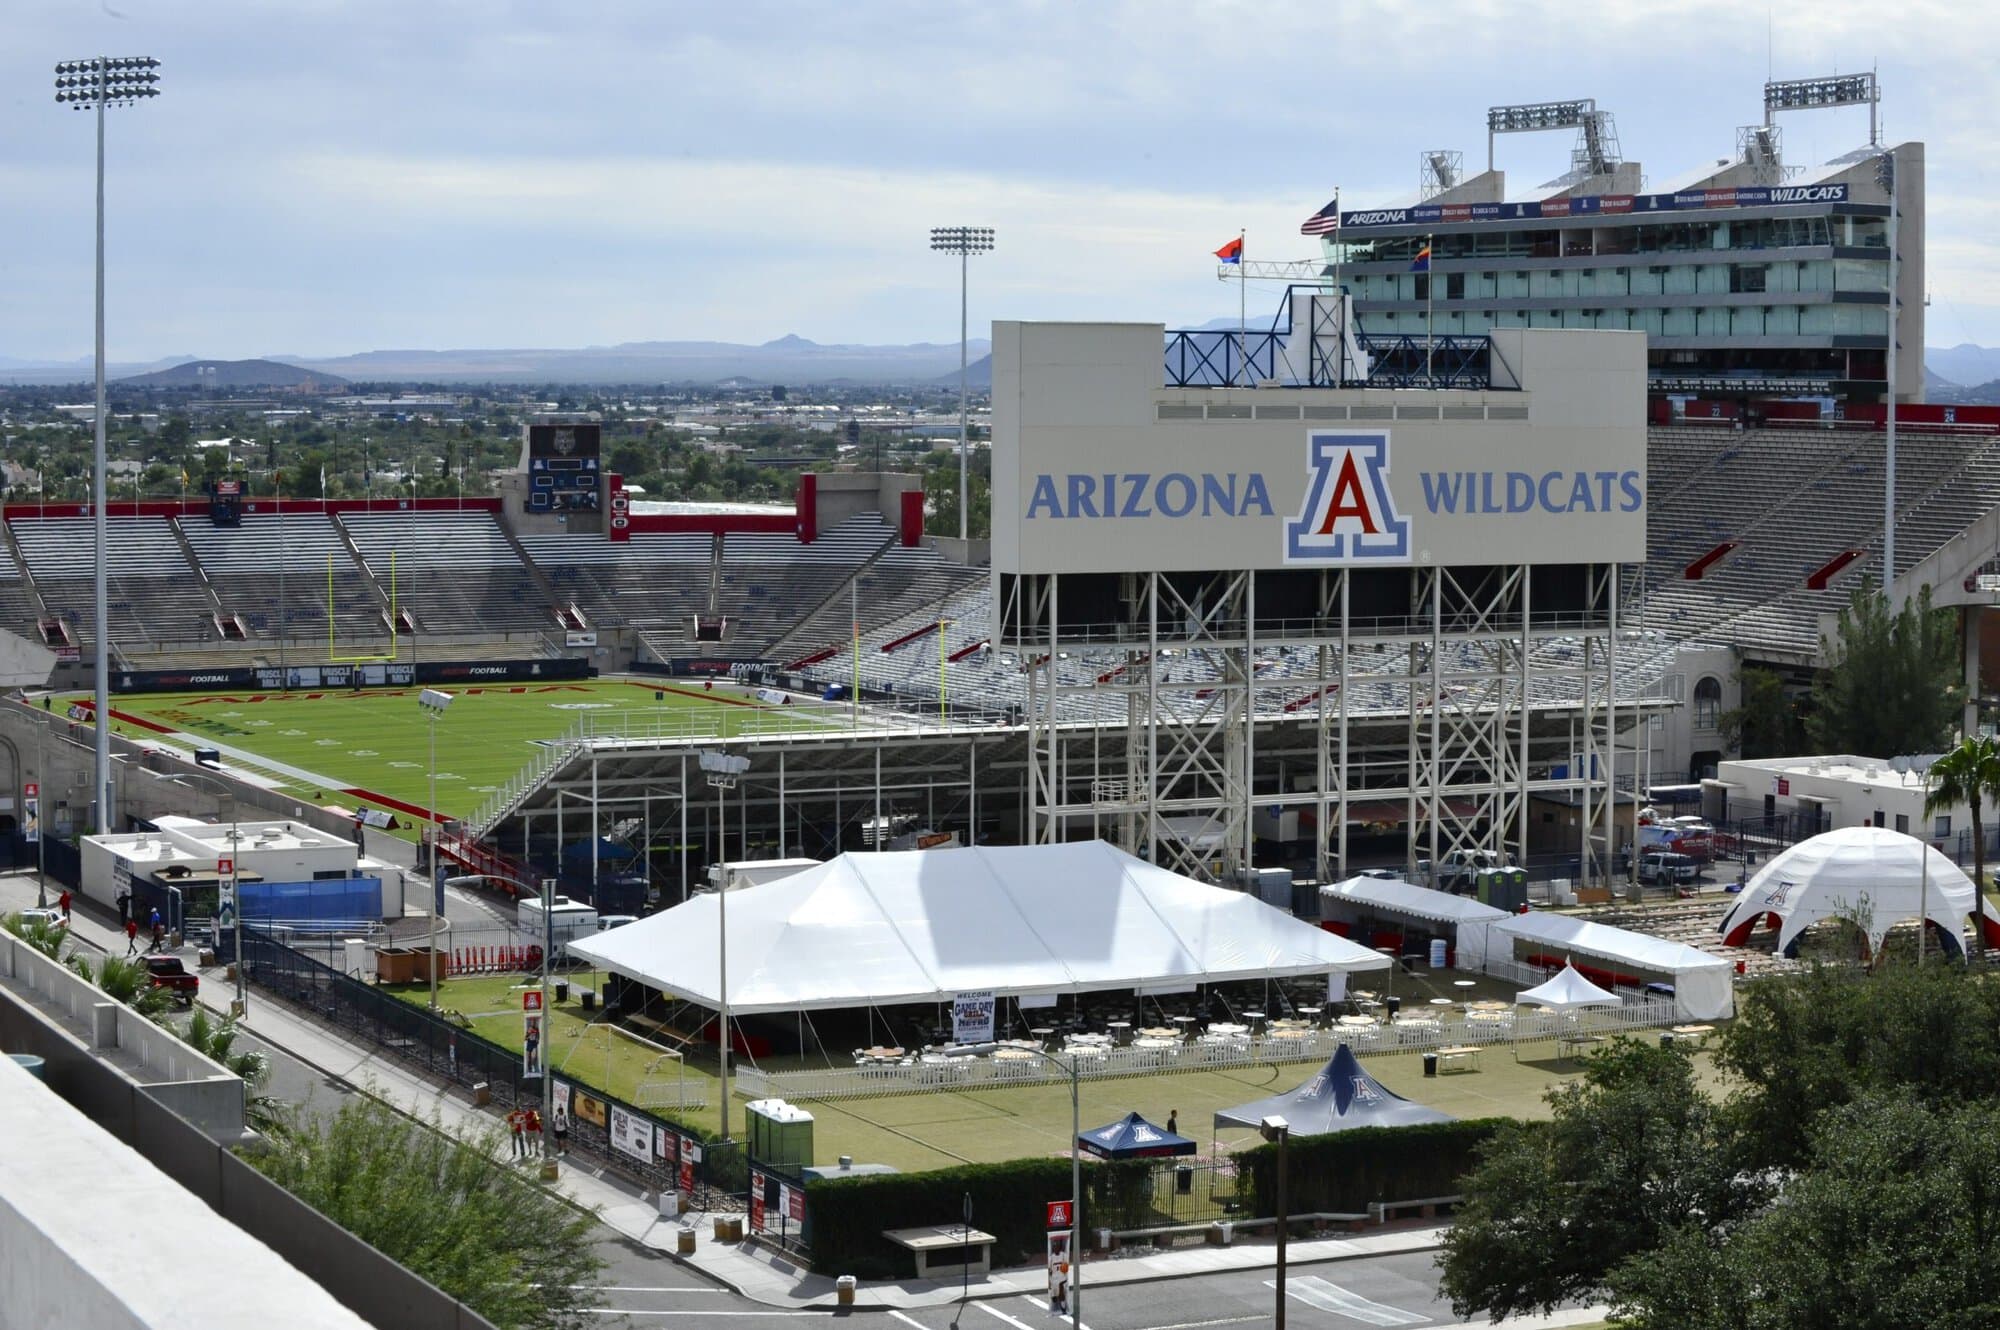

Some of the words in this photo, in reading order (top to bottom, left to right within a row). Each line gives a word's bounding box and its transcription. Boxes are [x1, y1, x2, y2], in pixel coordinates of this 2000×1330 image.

[1770, 186, 1844, 202] WILDCATS
[1347, 210, 1407, 225] ARIZONA
[1026, 472, 1275, 519] ARIZONA
[1284, 430, 1411, 564] A
[1420, 471, 1642, 514] WILDCATS
[190, 675, 230, 683] FOOTBALL
[957, 991, 993, 999] WELCOME
[955, 1003, 977, 1017] GAME
[978, 1001, 994, 1014] DAY
